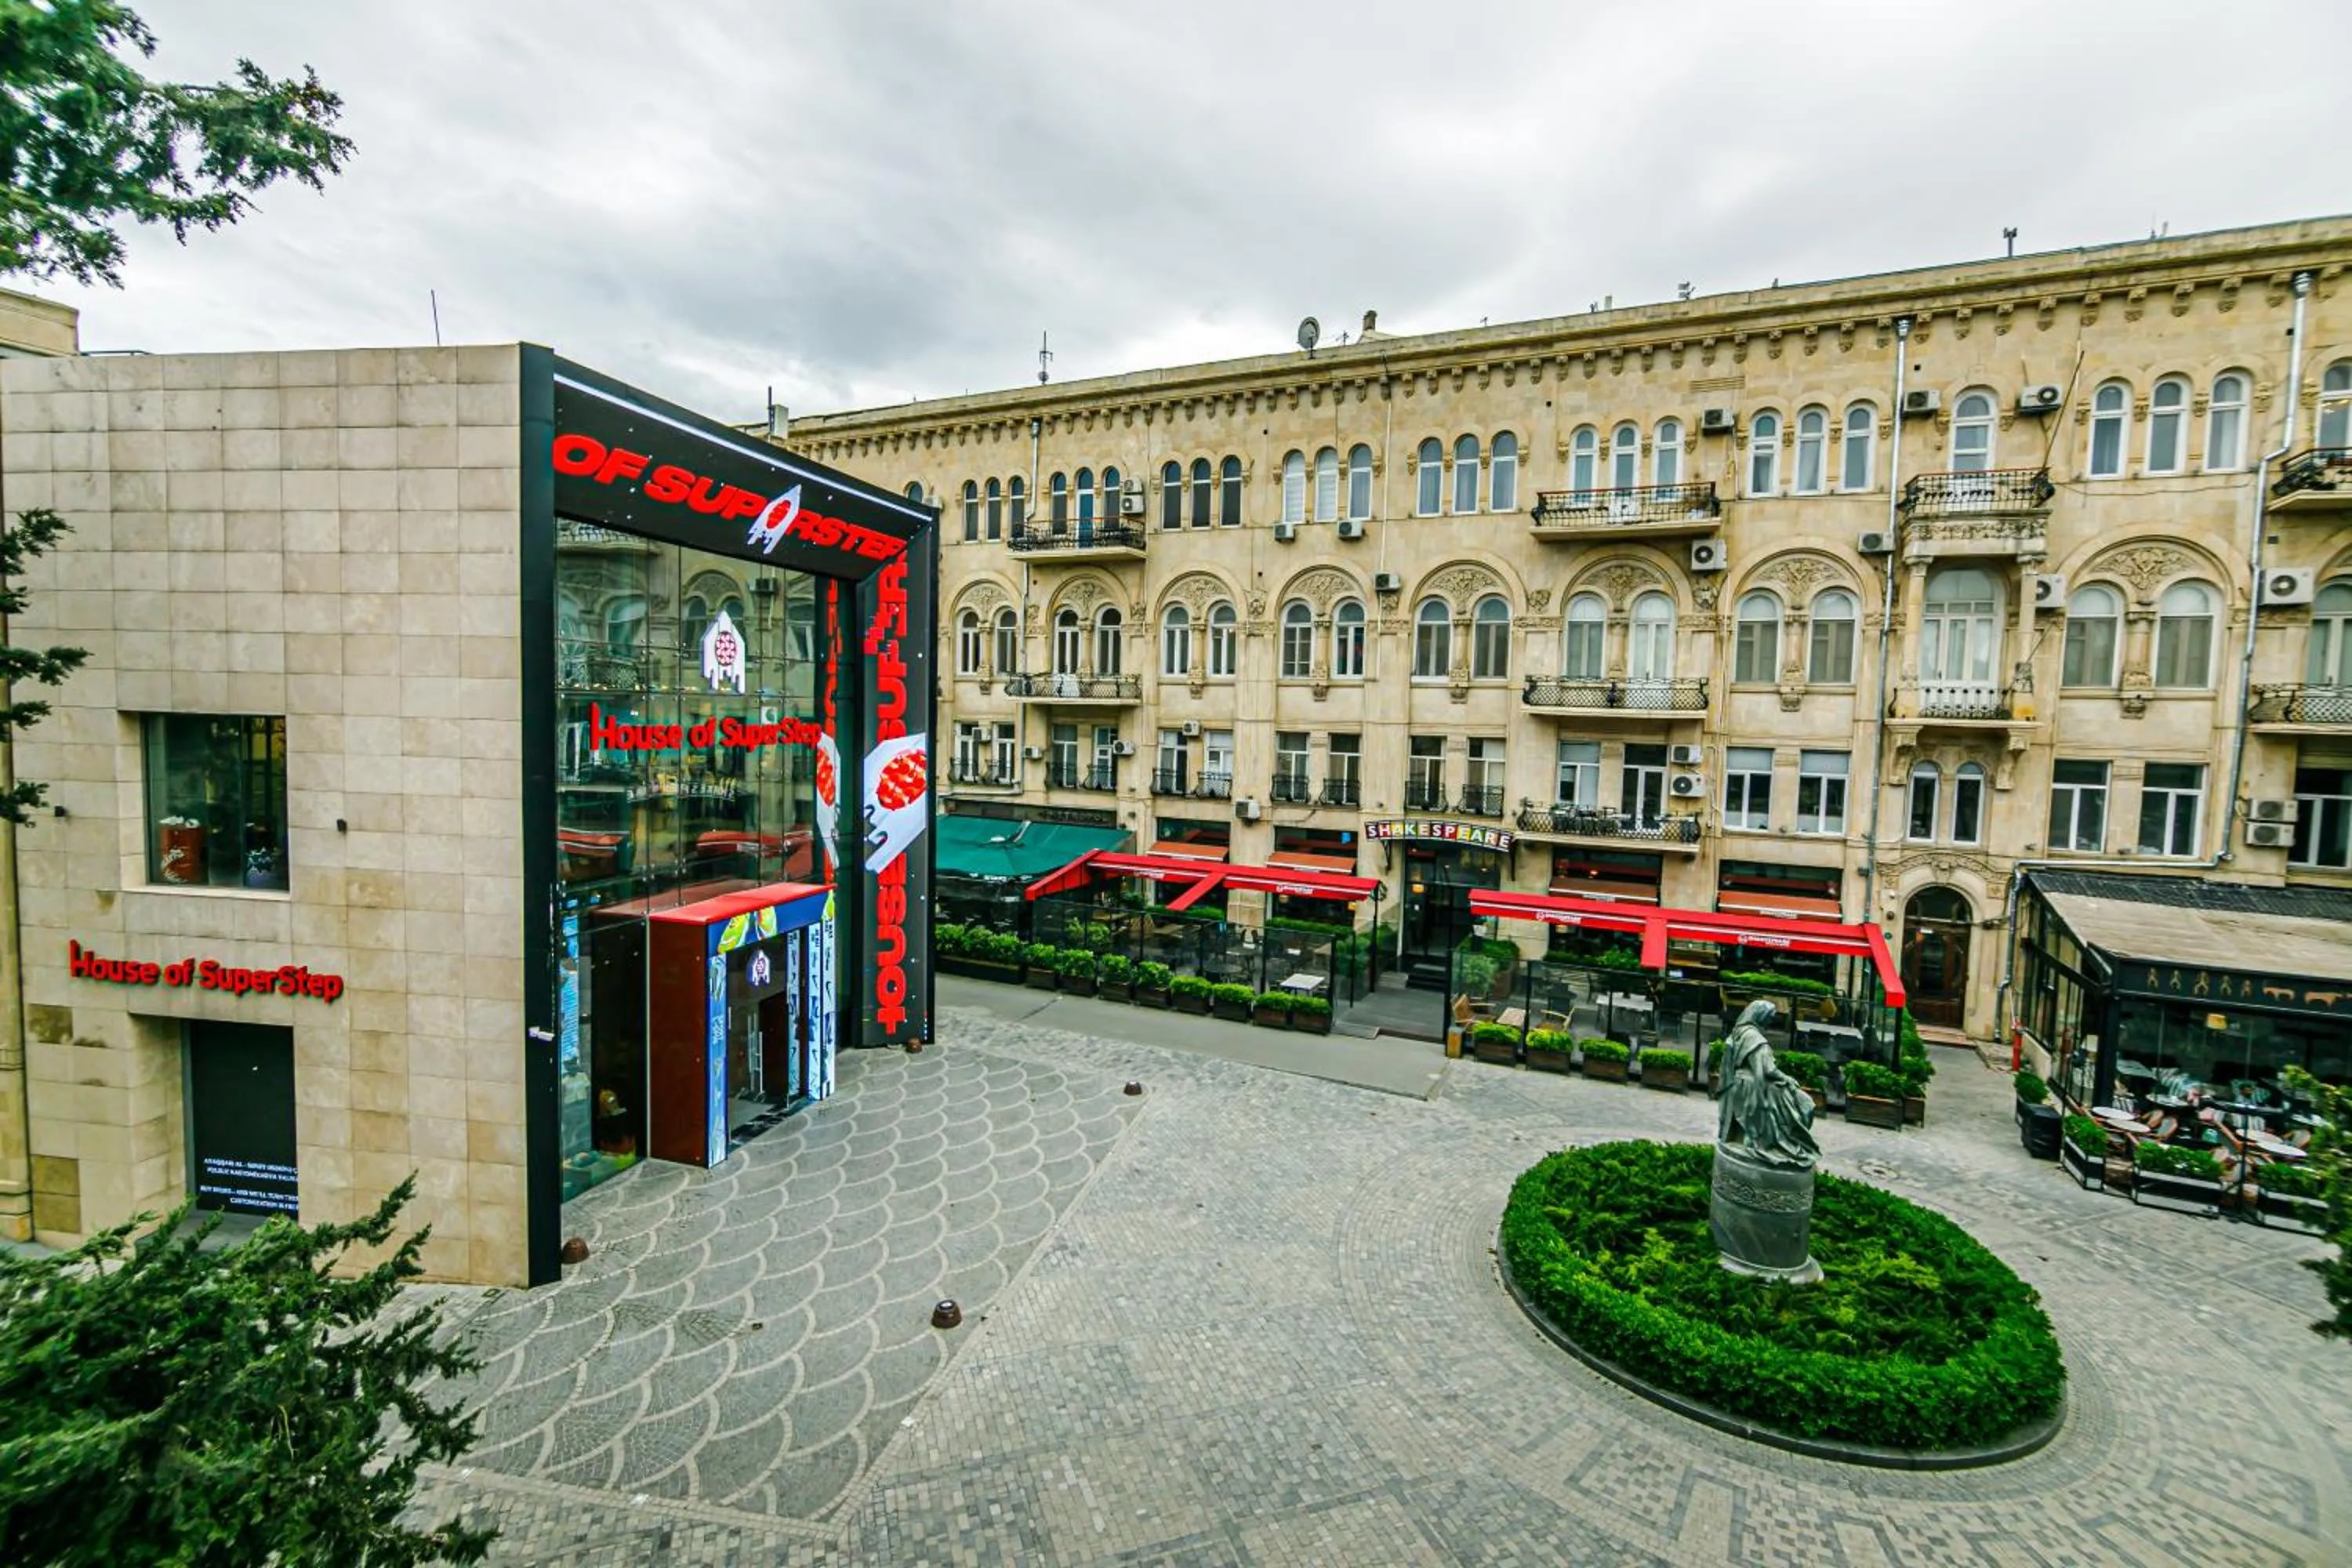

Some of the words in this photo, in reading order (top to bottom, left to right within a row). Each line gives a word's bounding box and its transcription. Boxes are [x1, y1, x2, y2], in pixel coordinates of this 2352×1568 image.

[552, 434, 651, 485] OF
[590, 702, 684, 750] House
[690, 717, 717, 748] of
[720, 717, 822, 752] SuperStep
[1367, 821, 1512, 849] SHAKESPEARE
[69, 939, 161, 984] House
[164, 958, 195, 987] of
[199, 960, 344, 1004] SuperStep
